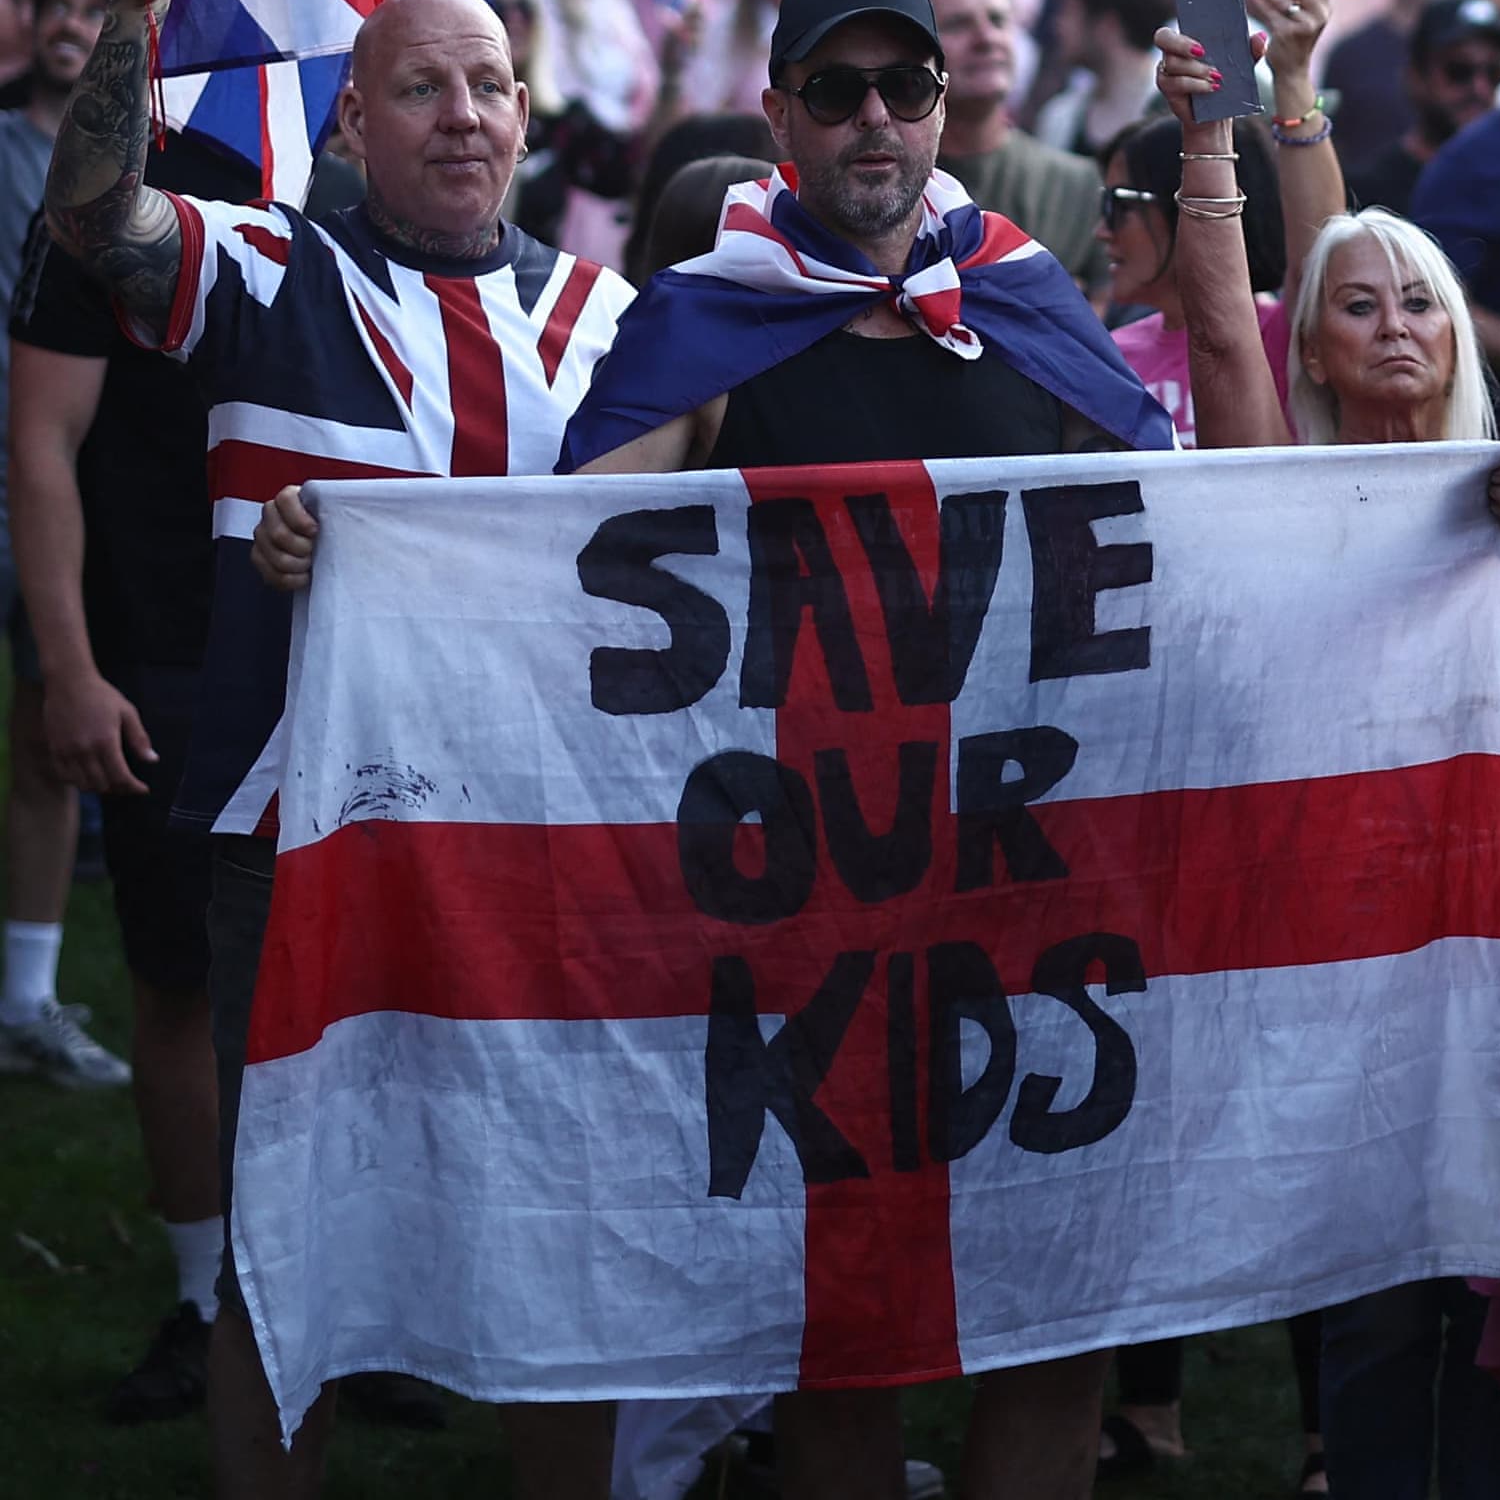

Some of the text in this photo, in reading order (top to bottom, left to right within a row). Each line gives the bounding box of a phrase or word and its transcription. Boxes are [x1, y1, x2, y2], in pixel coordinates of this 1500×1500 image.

[576, 479, 1156, 716] SAVE
[676, 724, 1079, 925] OUR
[703, 931, 1146, 1201] KIDS
